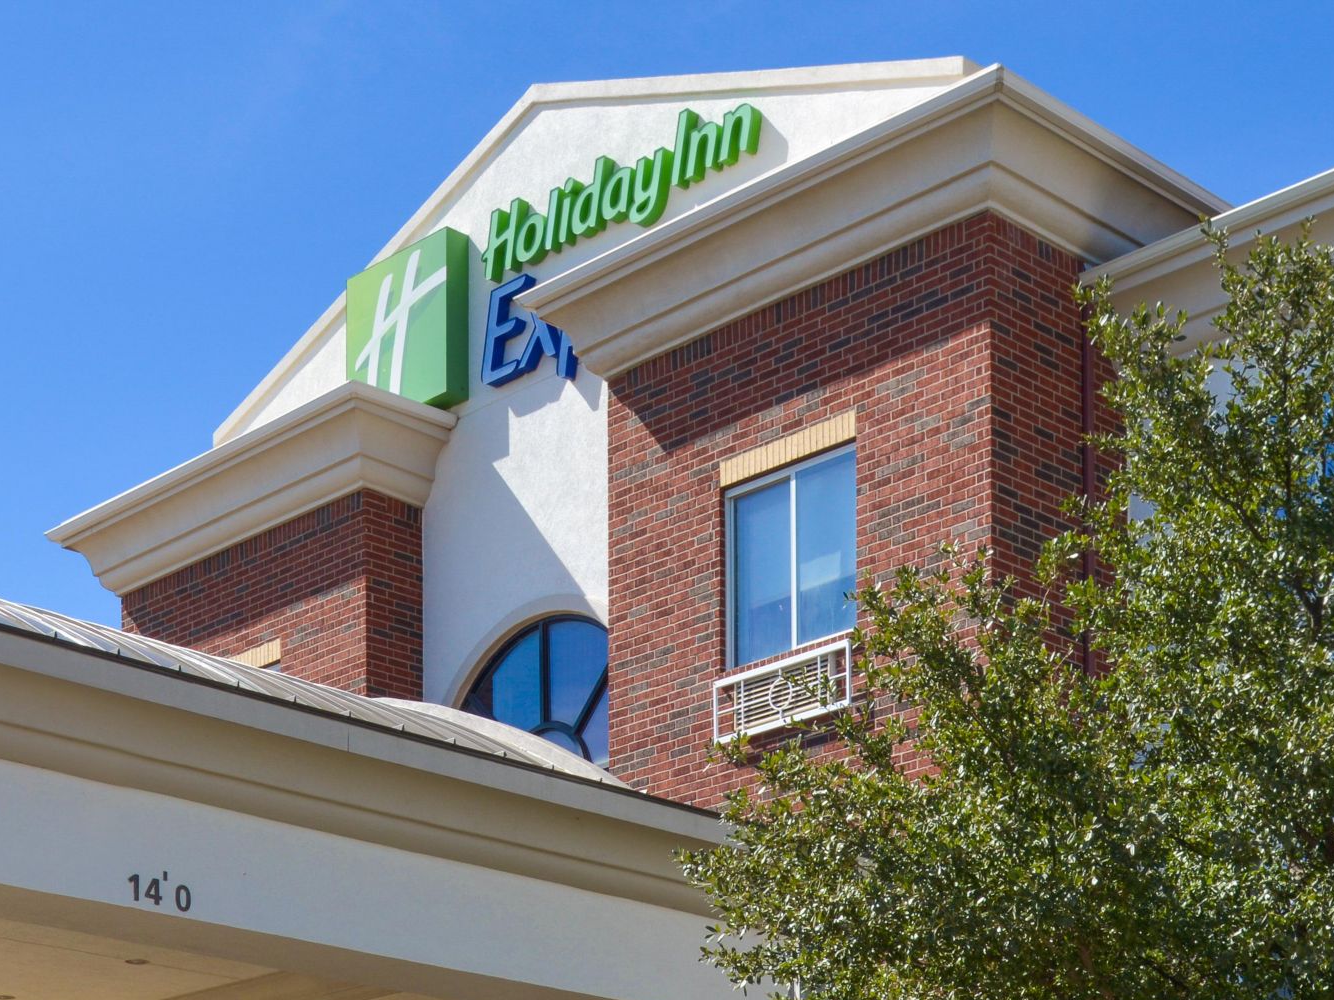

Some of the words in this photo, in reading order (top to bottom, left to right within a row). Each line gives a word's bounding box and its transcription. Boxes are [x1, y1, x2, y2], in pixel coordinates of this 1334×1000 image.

[481, 145, 673, 283] Holiday
[671, 103, 763, 189] Inn
[481, 273, 579, 389] Ex
